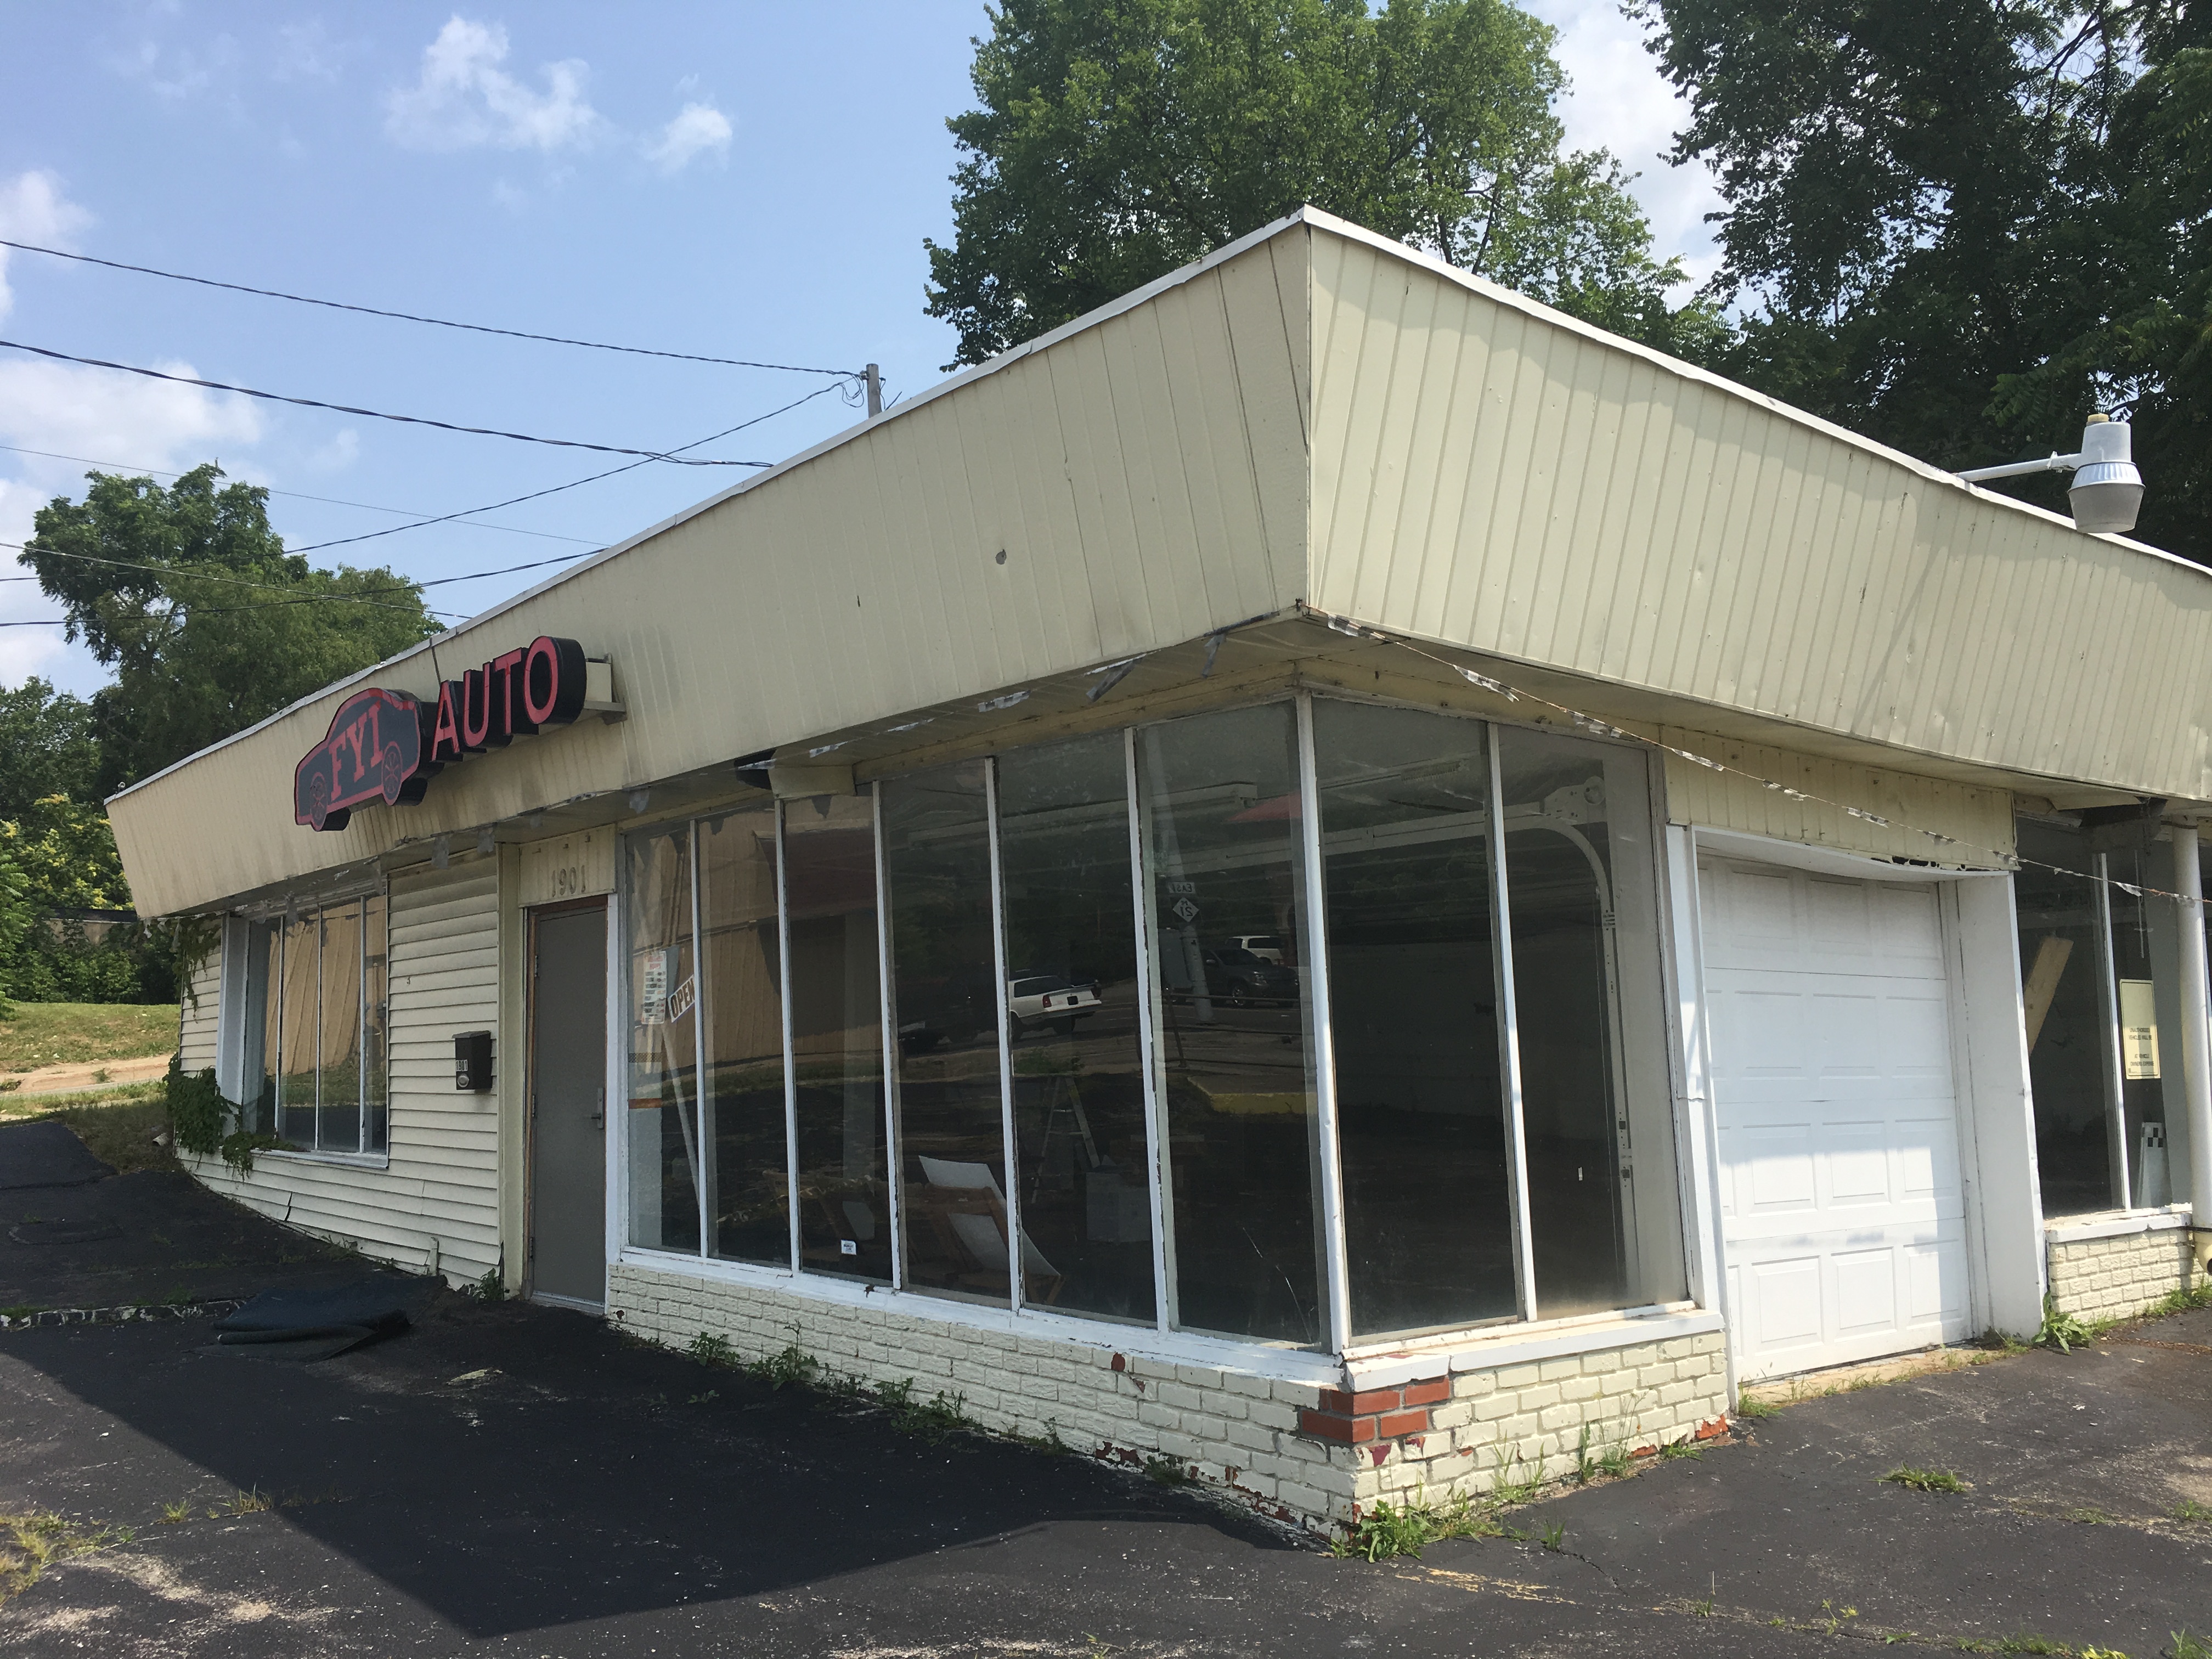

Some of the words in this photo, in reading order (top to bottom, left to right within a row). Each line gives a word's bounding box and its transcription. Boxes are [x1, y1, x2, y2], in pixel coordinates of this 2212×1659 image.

[329, 699, 383, 800] FYI
[431, 635, 558, 761] AUTO
[551, 865, 586, 898] 1901
[456, 1060, 467, 1070] 1901
